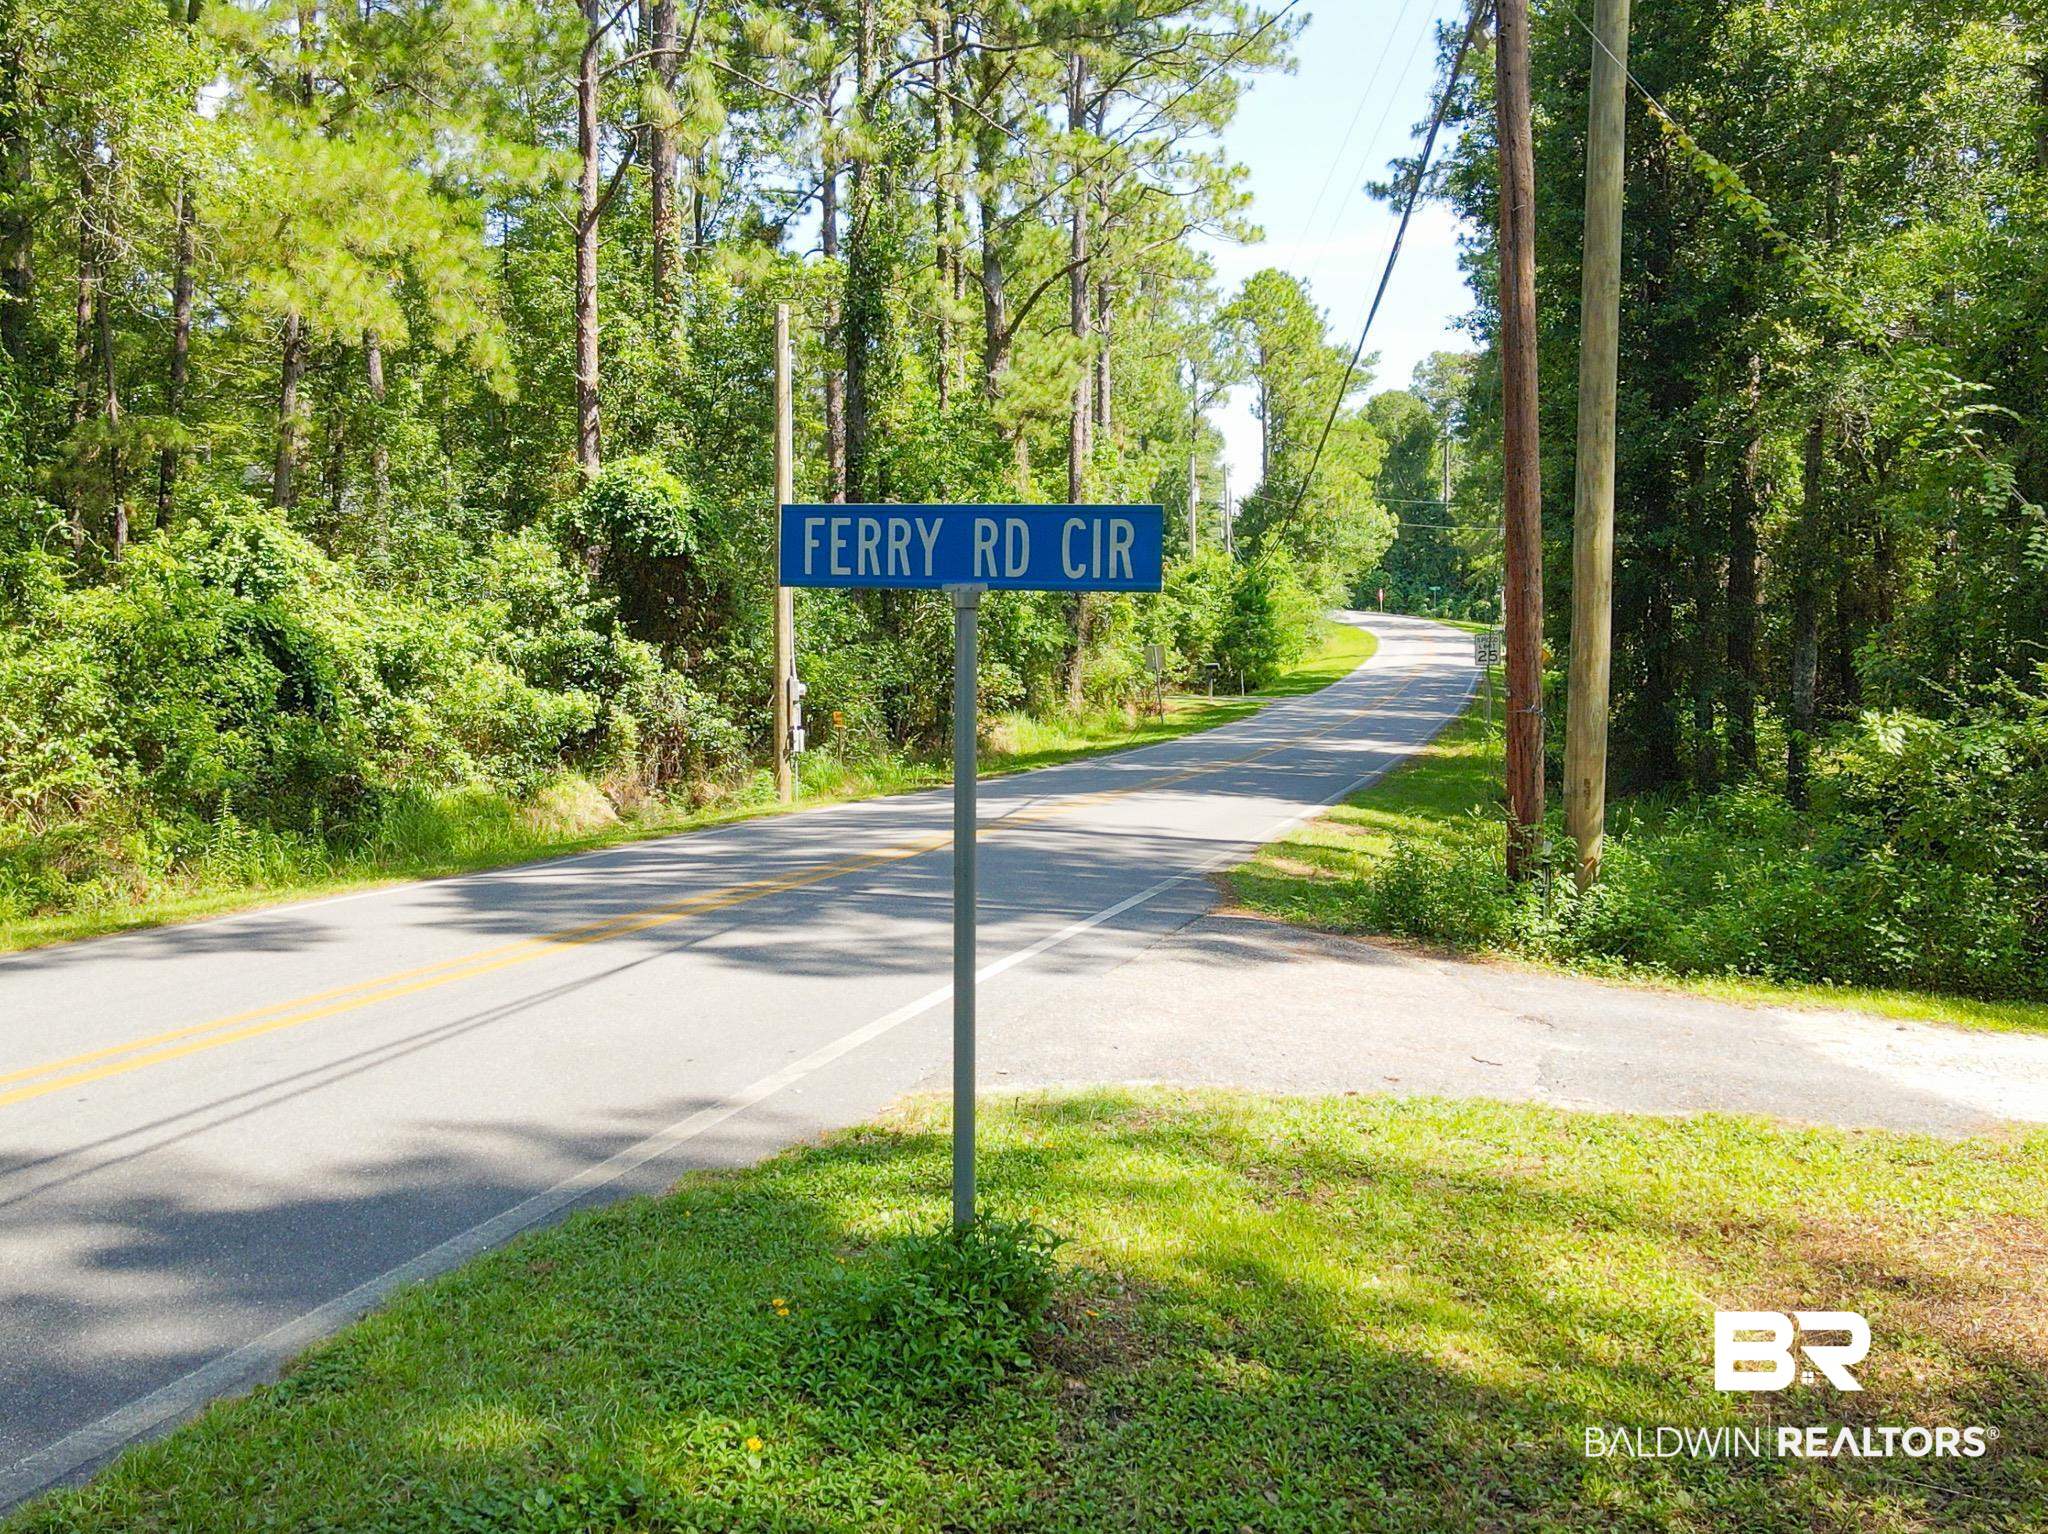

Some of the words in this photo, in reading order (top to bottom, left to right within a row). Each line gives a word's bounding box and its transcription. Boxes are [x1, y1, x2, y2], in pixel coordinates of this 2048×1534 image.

[804, 517, 943, 576] FERRY
[973, 518, 1030, 578] RD
[1061, 518, 1135, 579] CIR
[1477, 650, 1498, 662] 25
